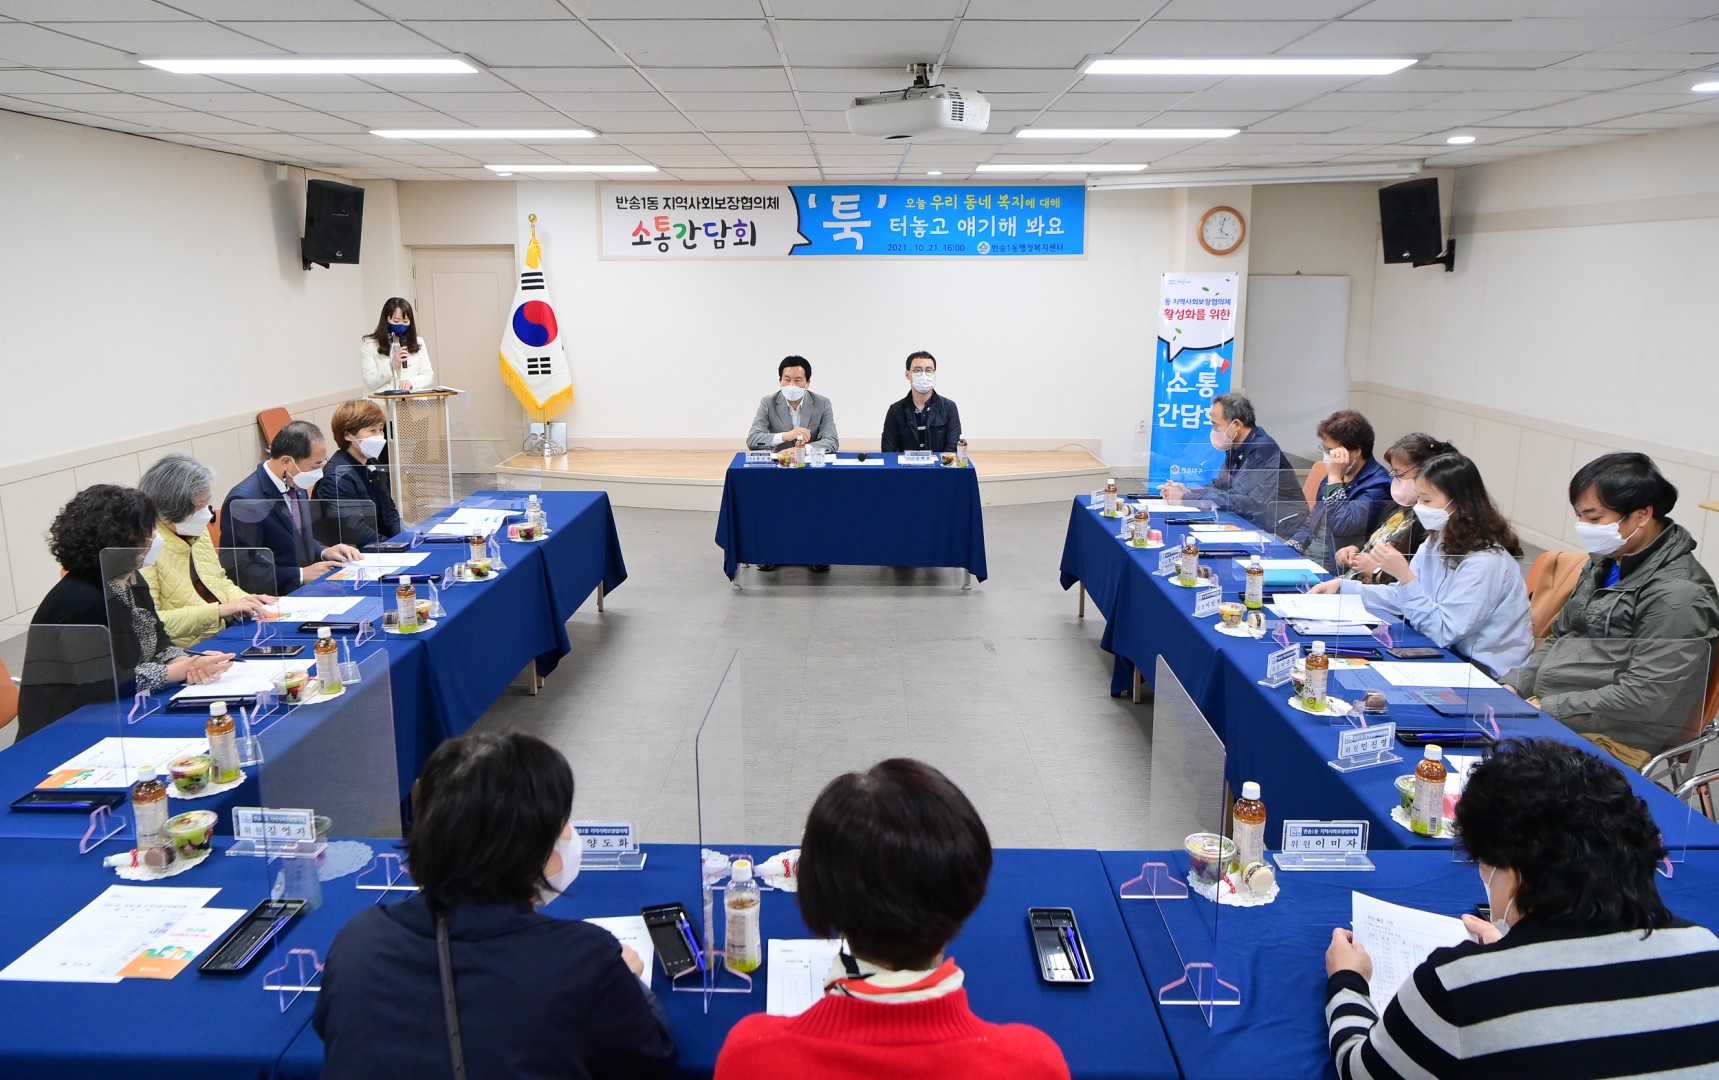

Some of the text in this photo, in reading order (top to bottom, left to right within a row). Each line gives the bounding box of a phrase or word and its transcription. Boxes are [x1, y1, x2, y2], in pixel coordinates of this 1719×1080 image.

[615, 195, 780, 211] 반송1동 지역사회보장협의체
[905, 194, 1061, 210] 오늘 우리 동네 복지에 대해
[631, 215, 757, 253] 소통간담회
[889, 215, 1065, 239] 터놓고 얘기해 봐요
[943, 244, 965, 252] 16:00
[991, 243, 1064, 253] 반송1동행정복지센터
[1163, 307, 1231, 321] 활성화를 위한
[1165, 371, 1219, 398] 소통
[1361, 738, 1387, 751] 민진영
[586, 837, 629, 849] 양도화
[1290, 837, 1358, 849] 위원 이미자
